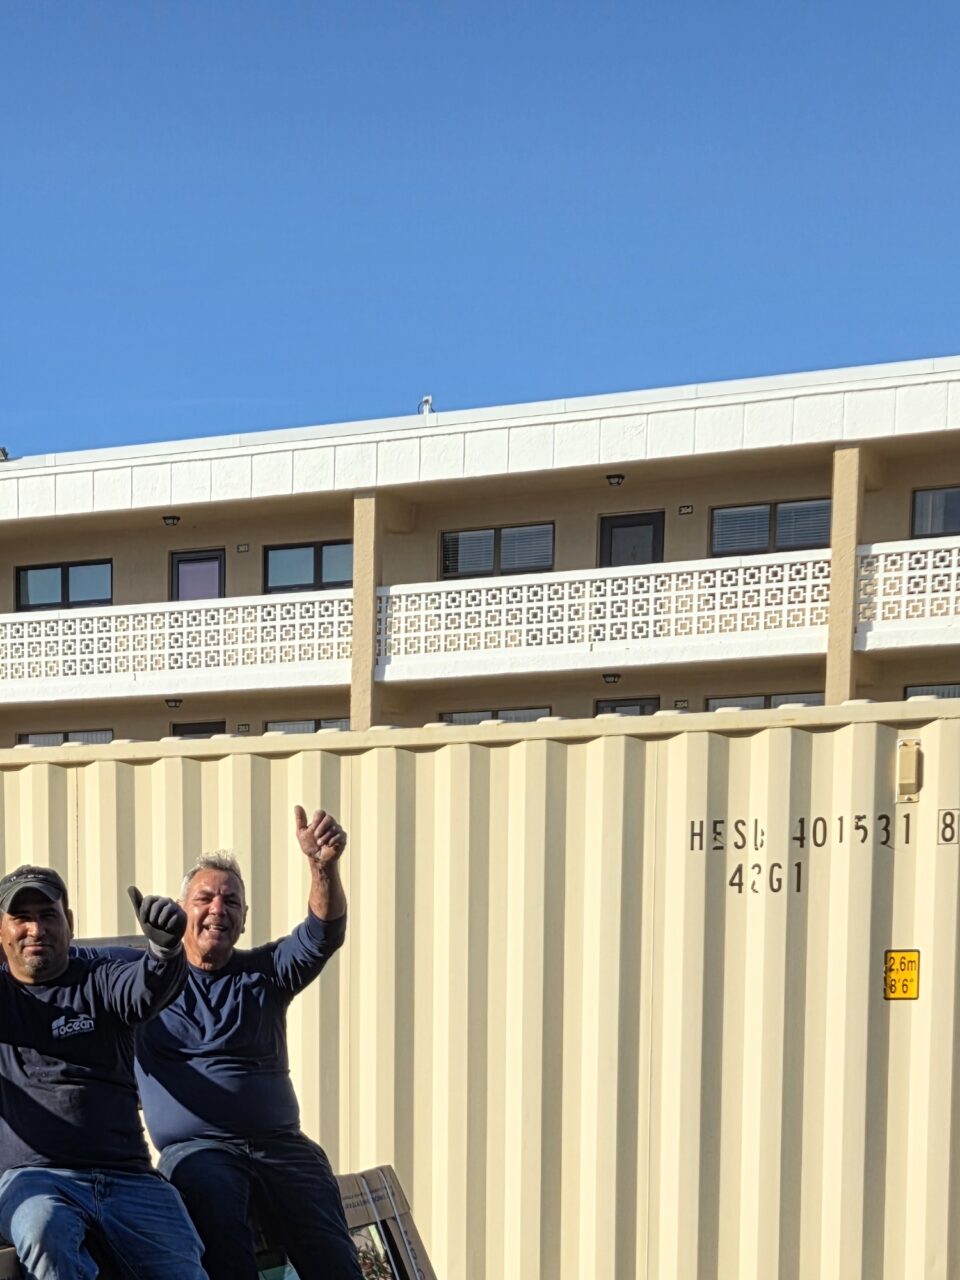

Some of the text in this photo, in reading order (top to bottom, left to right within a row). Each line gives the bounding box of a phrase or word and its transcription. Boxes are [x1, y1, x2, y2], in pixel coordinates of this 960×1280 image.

[792, 812, 911, 850] 401531
[941, 810, 956, 842] 8
[59, 1020, 94, 1035] ocean
